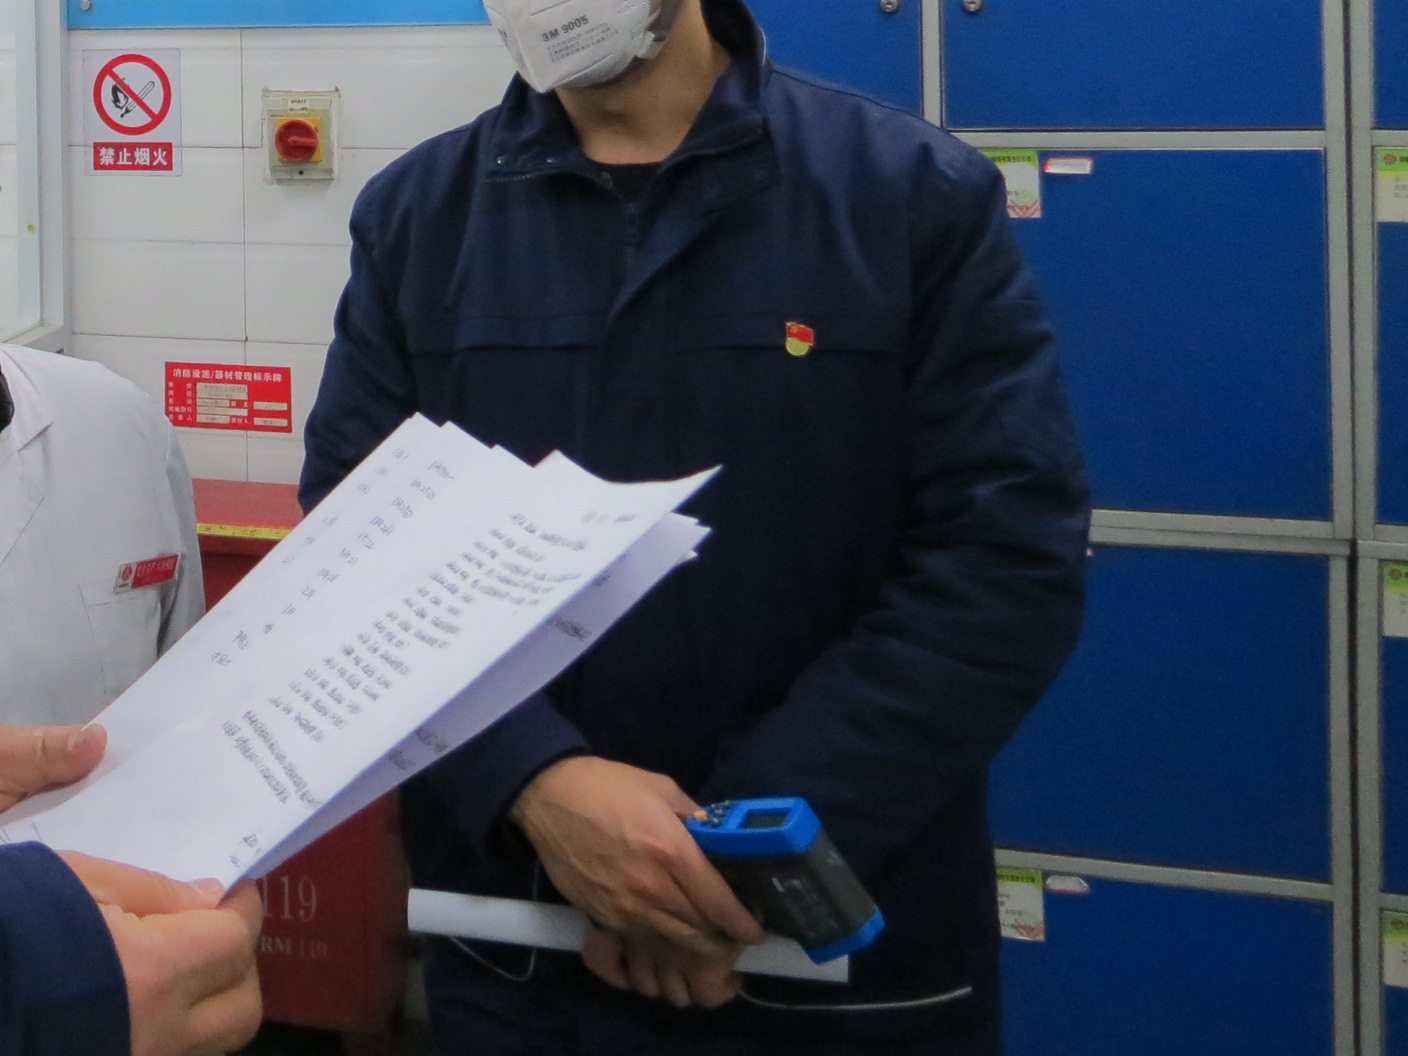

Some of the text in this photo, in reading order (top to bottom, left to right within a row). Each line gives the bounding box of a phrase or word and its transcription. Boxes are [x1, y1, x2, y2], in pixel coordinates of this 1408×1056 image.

[542, 15, 589, 42] 3M 9005
[99, 147, 168, 166] 禁止烟火
[262, 875, 317, 922] 119
